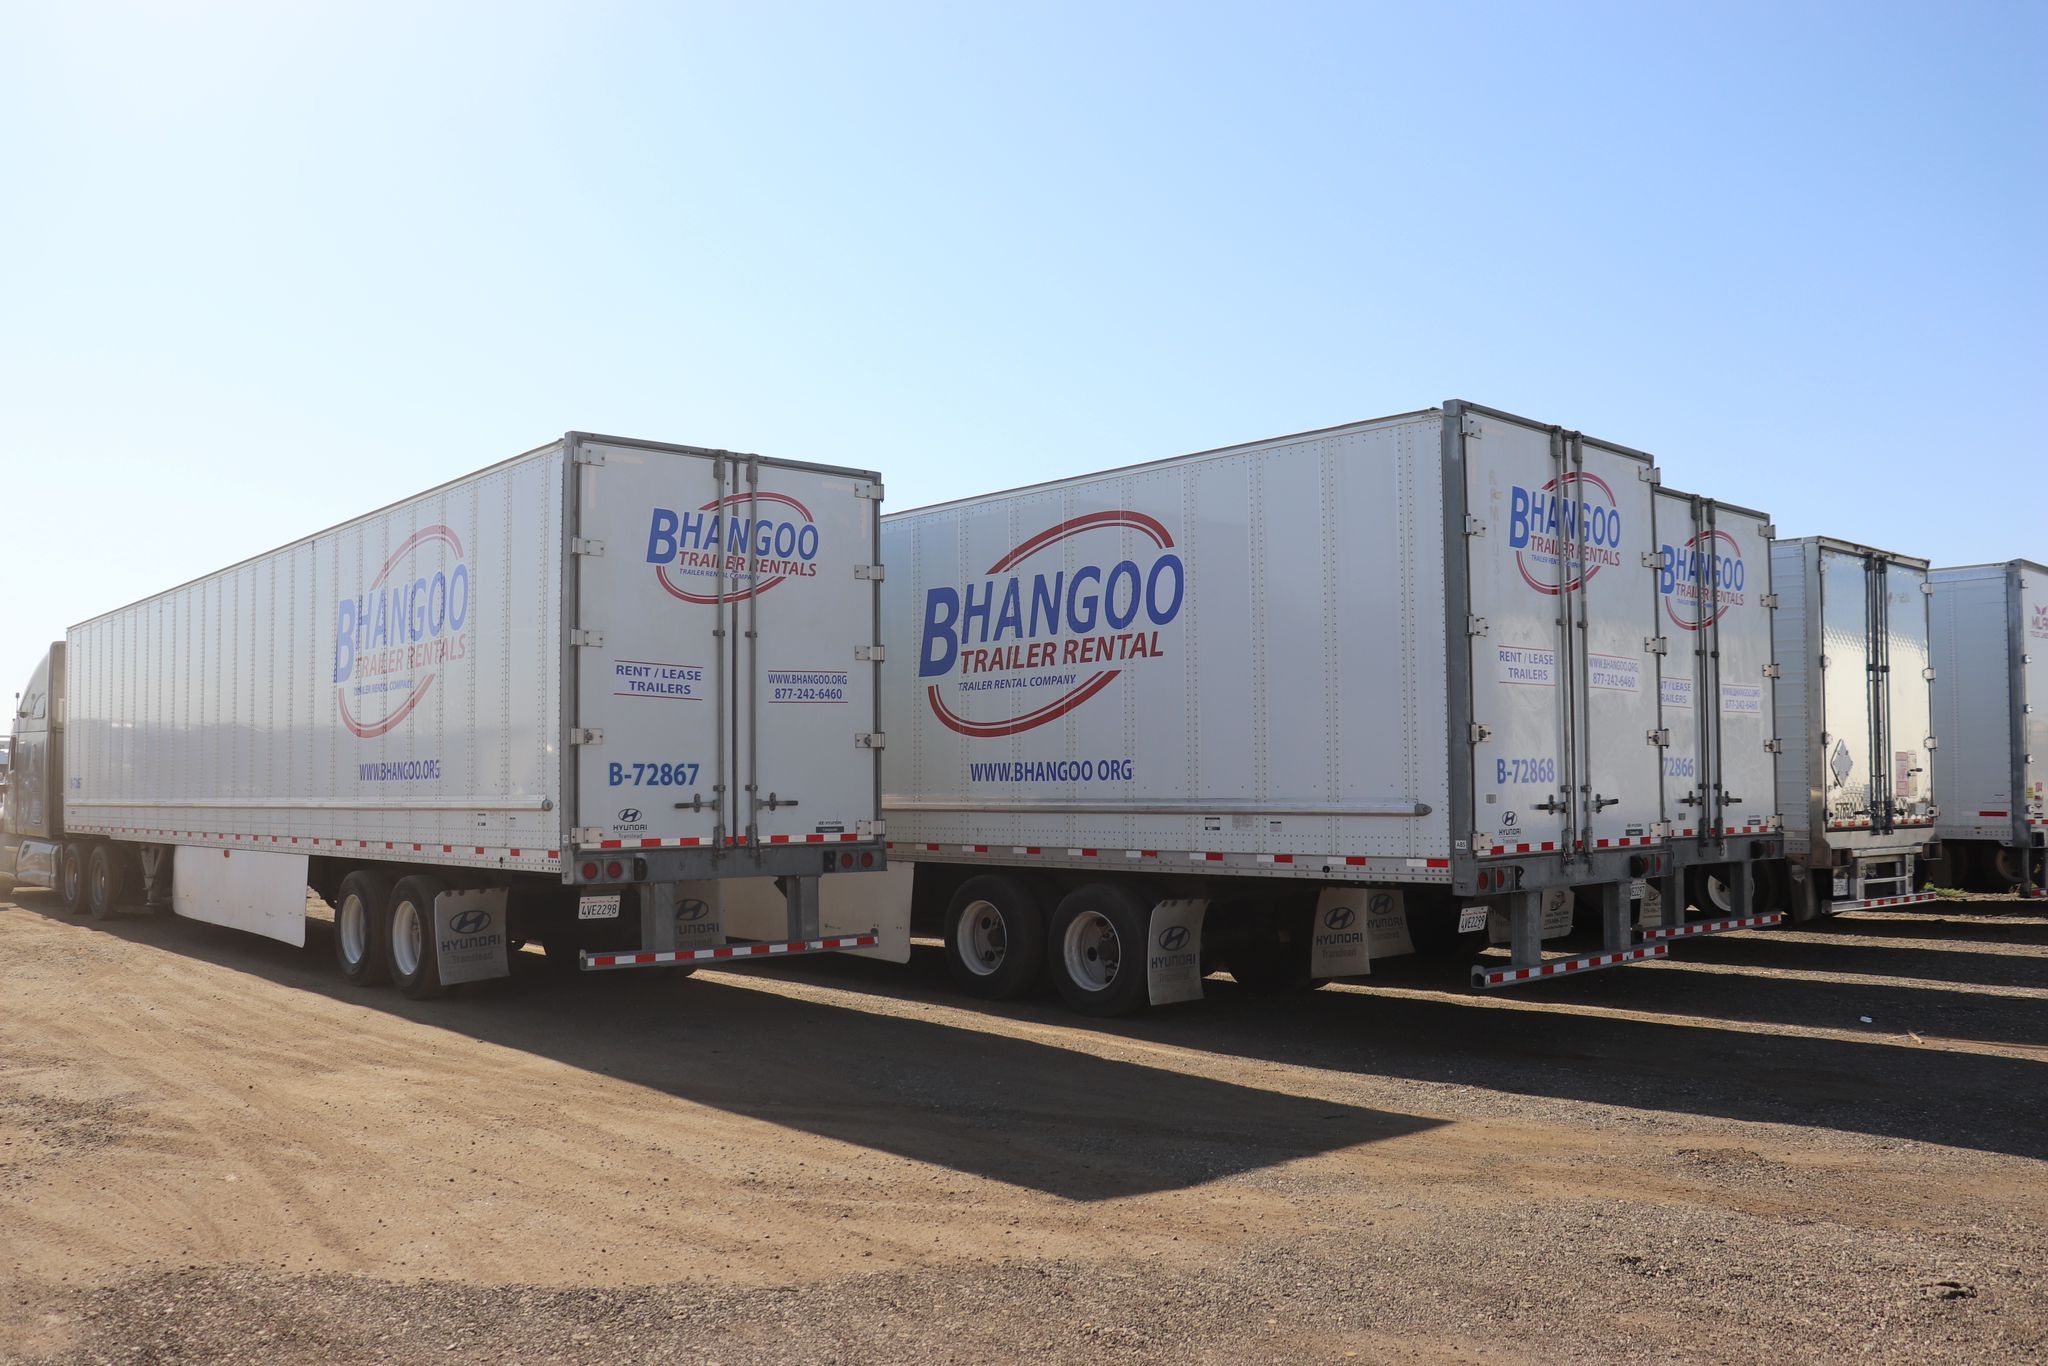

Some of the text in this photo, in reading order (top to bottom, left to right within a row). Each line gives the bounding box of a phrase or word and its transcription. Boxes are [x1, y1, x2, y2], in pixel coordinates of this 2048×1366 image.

[1509, 486, 1620, 549] BHANGOO
[646, 508, 818, 564] BHANGOO
[678, 551, 746, 572] TRAILER
[679, 568, 705, 577] TRAILER
[729, 573, 760, 581] COMPAY
[1716, 590, 1744, 606] ENTALS
[333, 563, 469, 683] BHANGOO
[918, 554, 1184, 677] BHANGOO
[355, 633, 466, 679] TRAILER RENTALS
[961, 631, 1164, 674] TRAILER RENTAL
[1499, 650, 1522, 663] RENT
[1529, 653, 1553, 665] LEASE
[615, 664, 651, 677] RENT
[662, 668, 701, 681] LEASE
[768, 674, 848, 685] WWW.BHANGOO.ORG
[1508, 667, 1548, 681] TRAILERS
[629, 680, 691, 695] TRAILERS
[958, 674, 1077, 692] TRAILER RENTAL COMPANY
[1672, 682, 1692, 692] LEASE
[775, 688, 842, 699] 877-242-6460
[1660, 694, 1688, 704] RAILERS
[360, 760, 441, 781] WWW.BHANGOO.ORG
[609, 762, 699, 786] B-72867
[1496, 758, 1555, 784] B-72868
[1662, 757, 1694, 778] 72866
[1456, 840, 1466, 848] ABS
[678, 922, 720, 935] UNDAI
[441, 934, 500, 952] HYUNDAI
[1316, 932, 1363, 946] HYUNDAI
